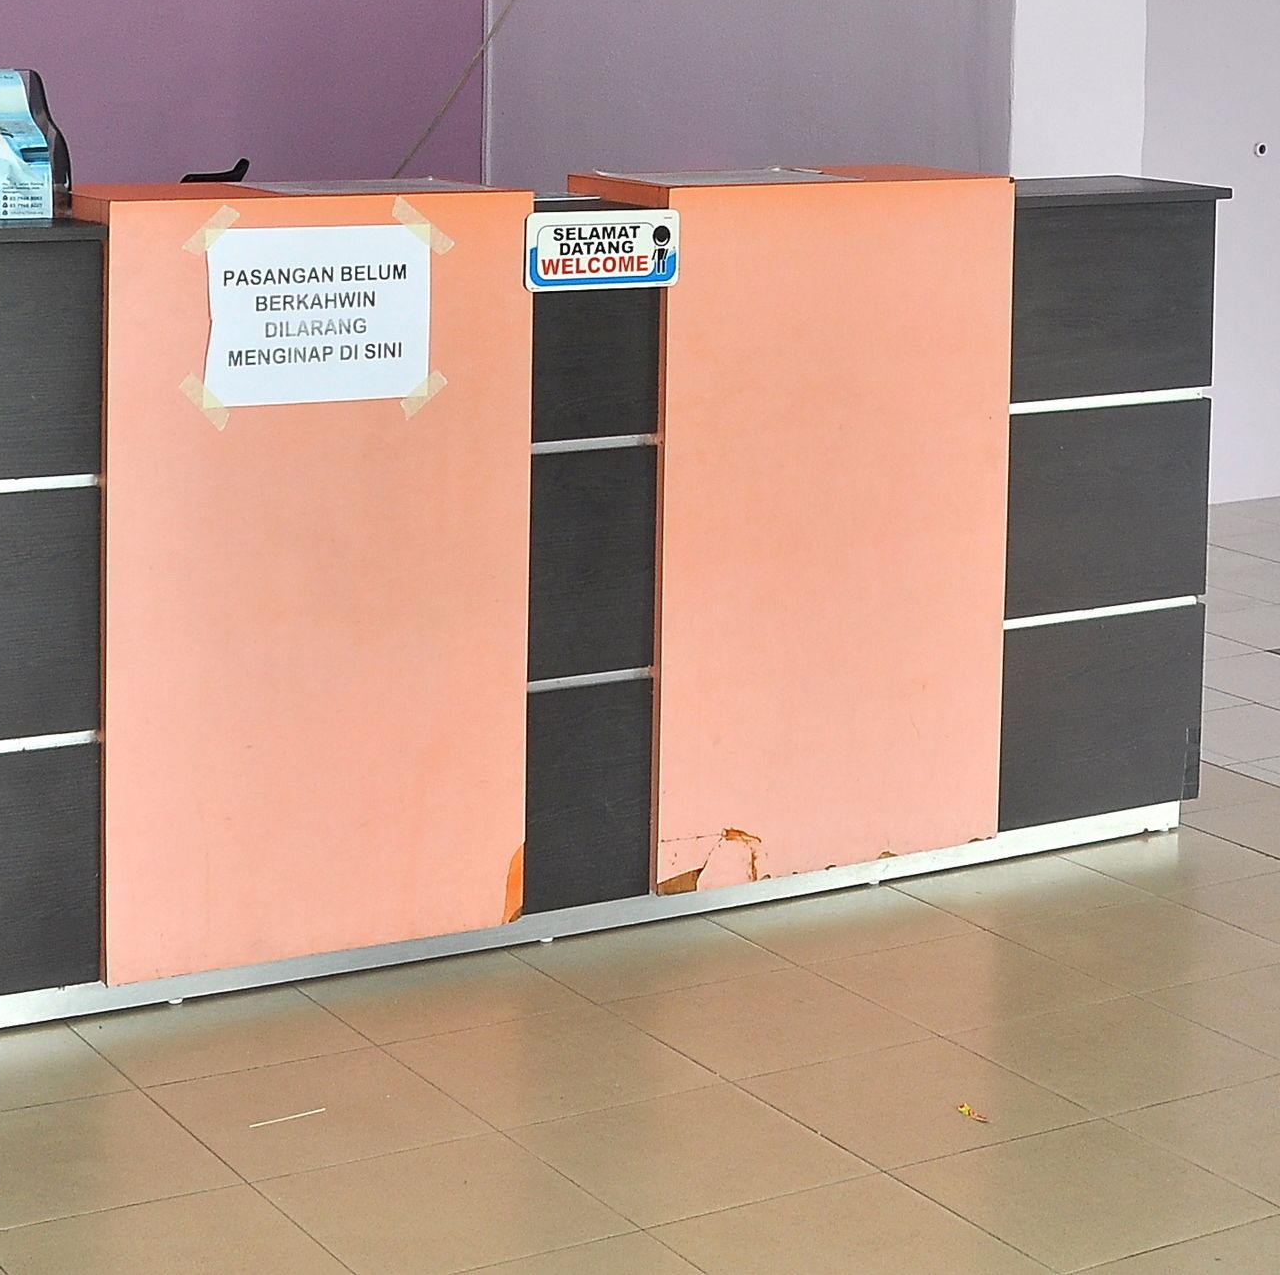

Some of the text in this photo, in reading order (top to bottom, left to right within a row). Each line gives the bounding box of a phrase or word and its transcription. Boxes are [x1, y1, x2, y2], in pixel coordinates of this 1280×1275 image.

[553, 226, 641, 241] SELAMAT
[559, 241, 634, 256] DATANG
[223, 264, 407, 286] PASANGAN BELUM
[541, 255, 649, 276] WELCOME
[255, 291, 376, 312] BERKAHWIN
[265, 318, 367, 338] DILARANG
[228, 342, 402, 367] MENGINAP DI SINI
